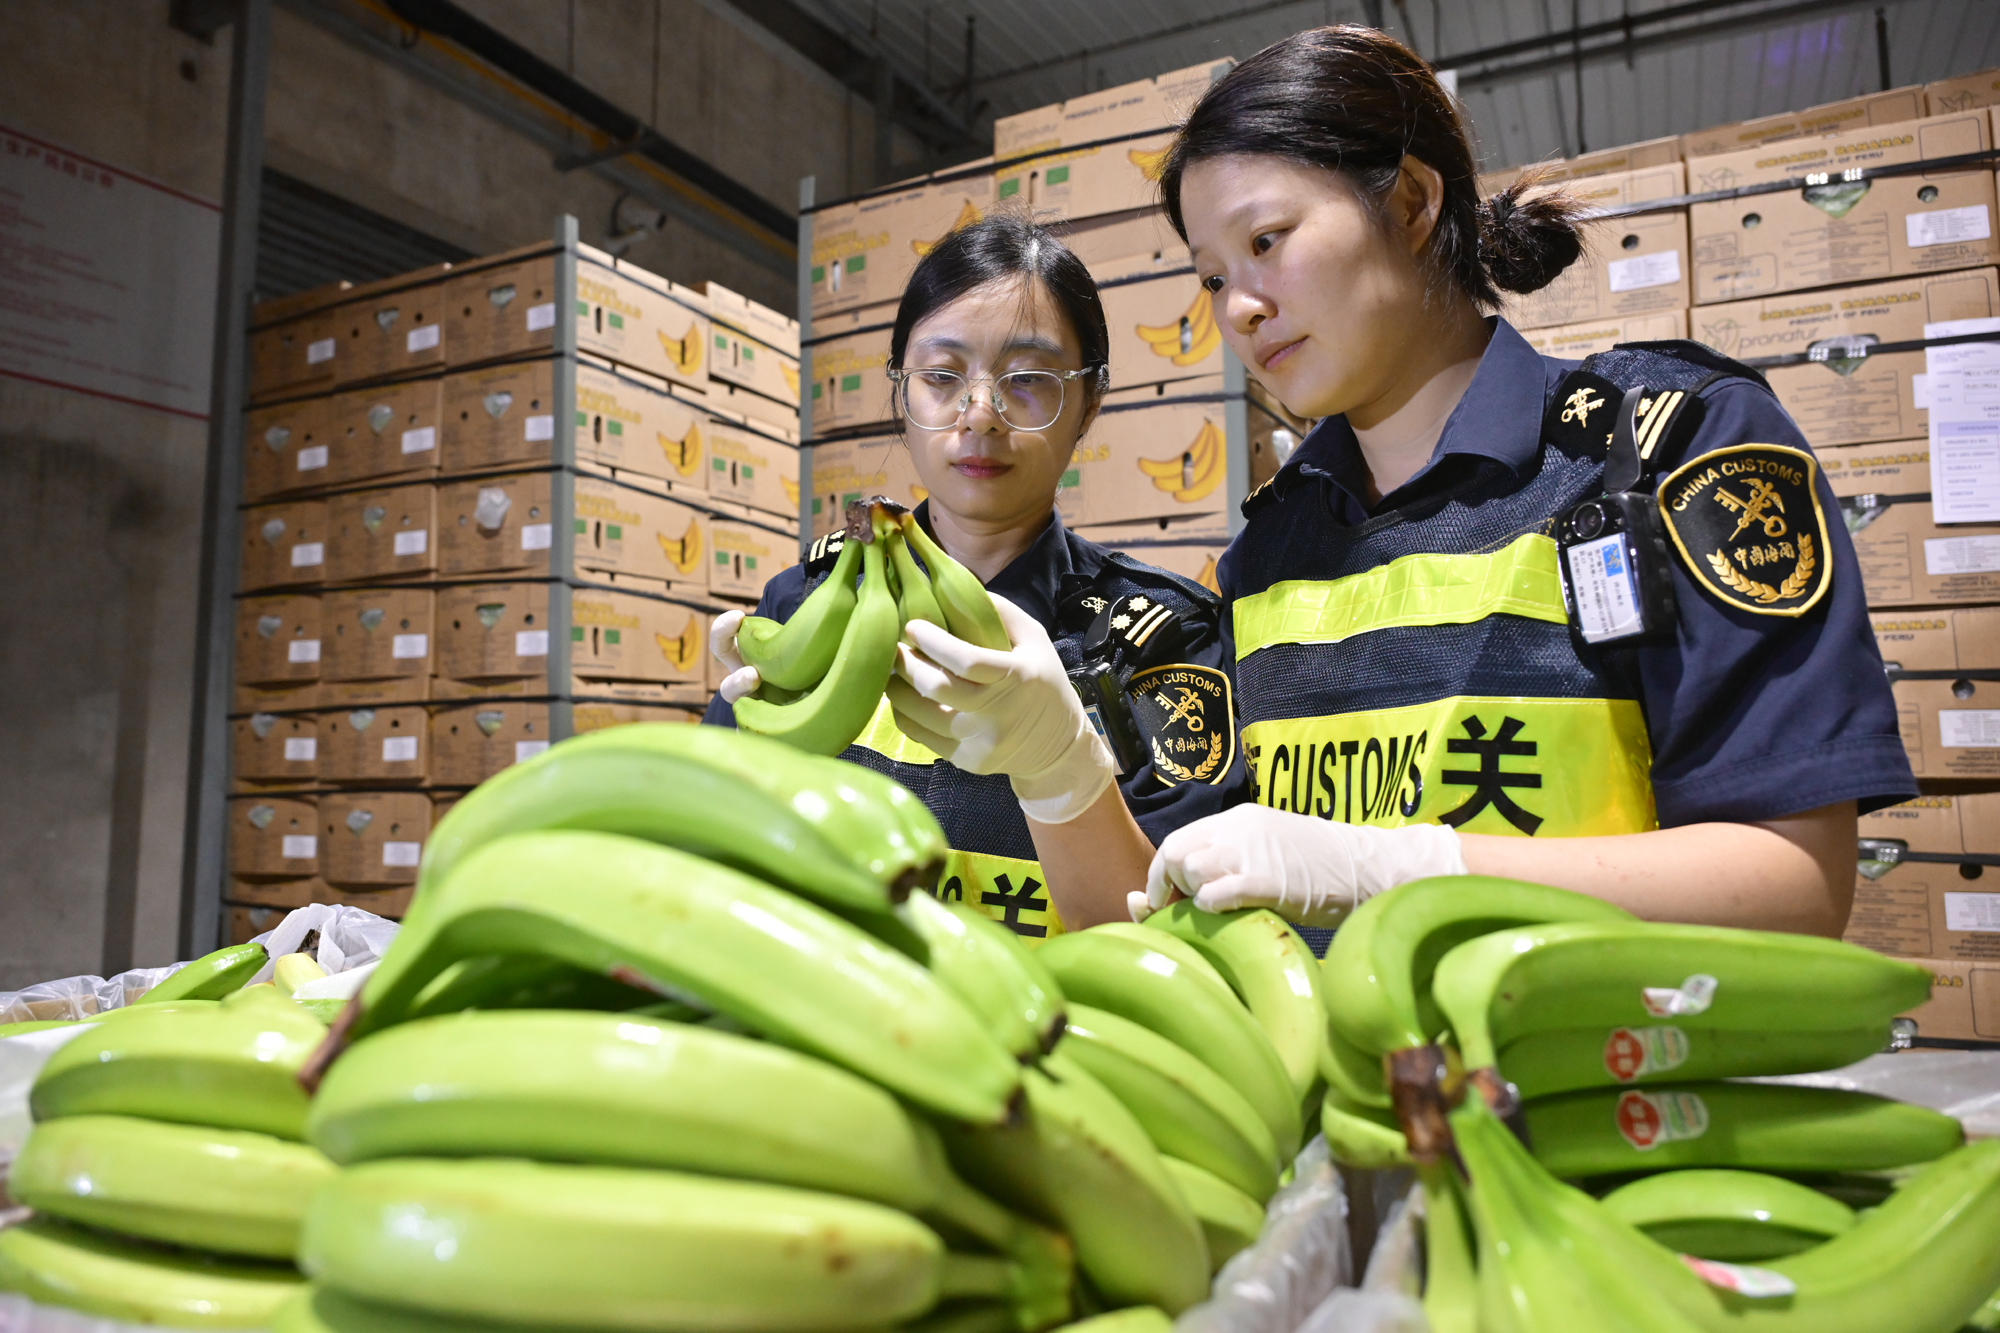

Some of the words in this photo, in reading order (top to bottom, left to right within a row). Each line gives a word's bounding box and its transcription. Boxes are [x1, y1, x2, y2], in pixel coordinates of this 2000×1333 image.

[1835, 135, 1914, 156] BANANAS
[1785, 160, 1834, 172] PRODUCT
[1855, 150, 1884, 161] PERU
[1840, 292, 1921, 311] BANANAS
[1789, 313, 1839, 326] PRODUCT
[1843, 308, 1857, 319] OF
[1860, 306, 1890, 317] PERU
[1739, 327, 1819, 350] pronatur
[1870, 466, 1901, 477] PERU
[1671, 467, 1721, 512] CHINA
[1721, 457, 1803, 486] CUSTOMS
[1871, 619, 1946, 632] ANANAS
[1162, 672, 1222, 697] CUSTOMS
[1268, 729, 1427, 824] CUSTOMS
[1437, 714, 1545, 837] 关
[1888, 810, 1919, 819] PERU
